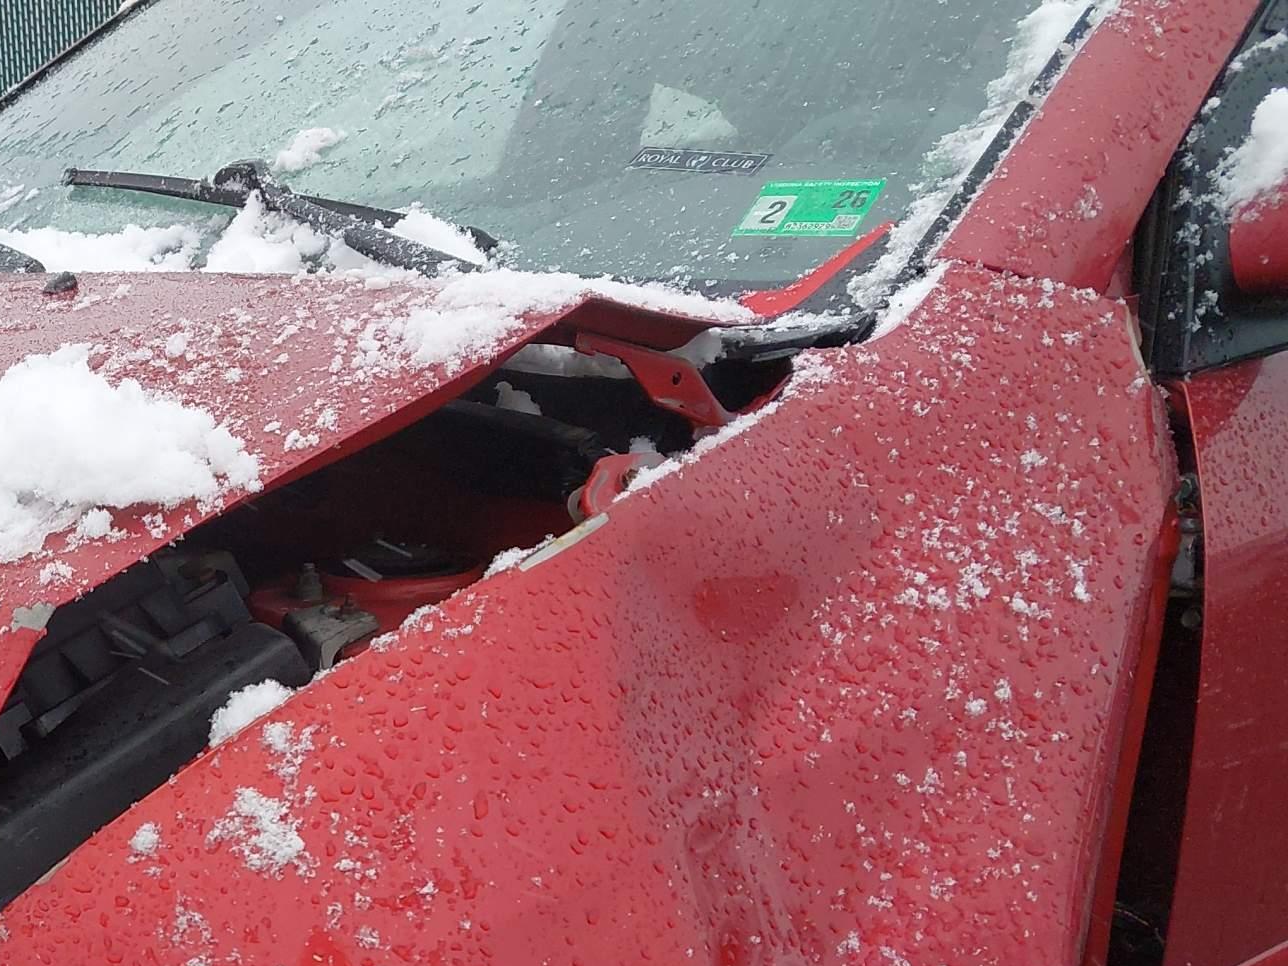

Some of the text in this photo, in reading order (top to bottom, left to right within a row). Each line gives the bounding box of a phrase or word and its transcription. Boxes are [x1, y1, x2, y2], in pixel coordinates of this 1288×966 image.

[638, 153, 755, 169] ROYAL CLUB
[832, 189, 870, 209] 26
[760, 200, 787, 224] 2
